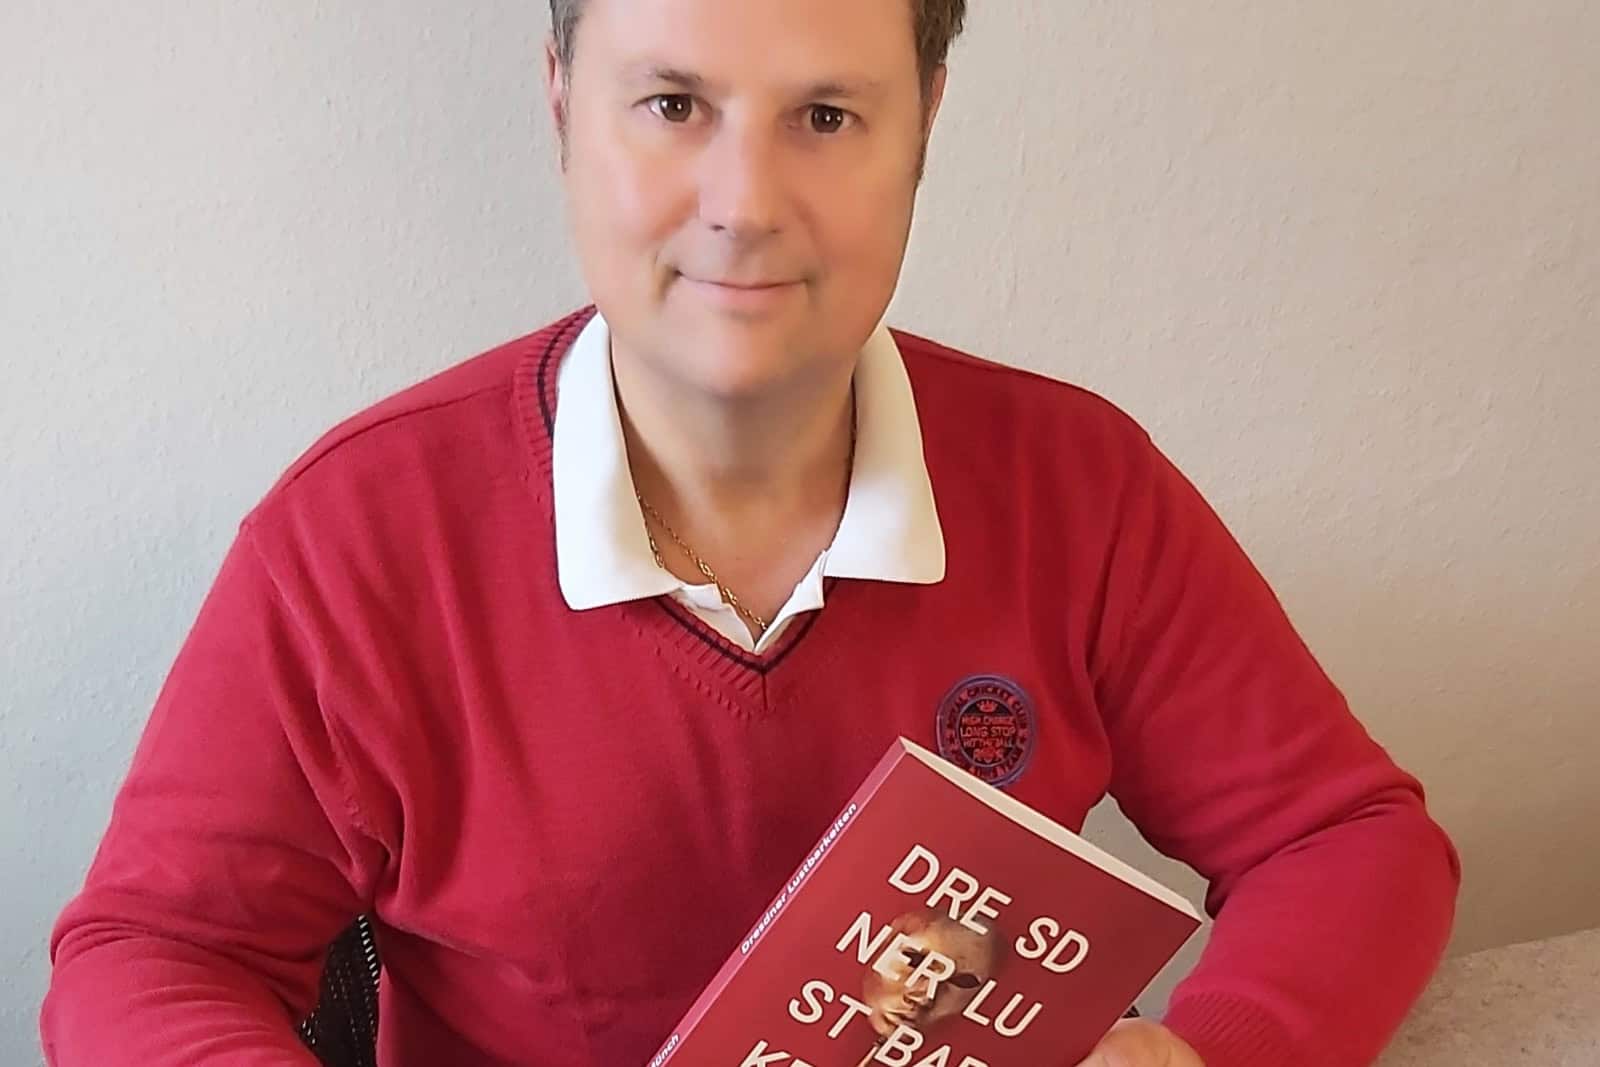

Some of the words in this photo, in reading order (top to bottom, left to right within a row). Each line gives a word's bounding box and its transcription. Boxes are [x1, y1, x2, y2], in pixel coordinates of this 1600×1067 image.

[960, 726, 988, 737] LONG
[990, 726, 1016, 737] STOP
[741, 892, 787, 954] Dresdner
[786, 803, 857, 894] Lustbarkeiten
[888, 844, 1012, 935] DRE
[1015, 916, 1089, 973] SD
[788, 980, 873, 1038] ST
[874, 1024, 989, 1067] BA
[835, 911, 955, 1000] NER
[963, 980, 1042, 1037] LU
